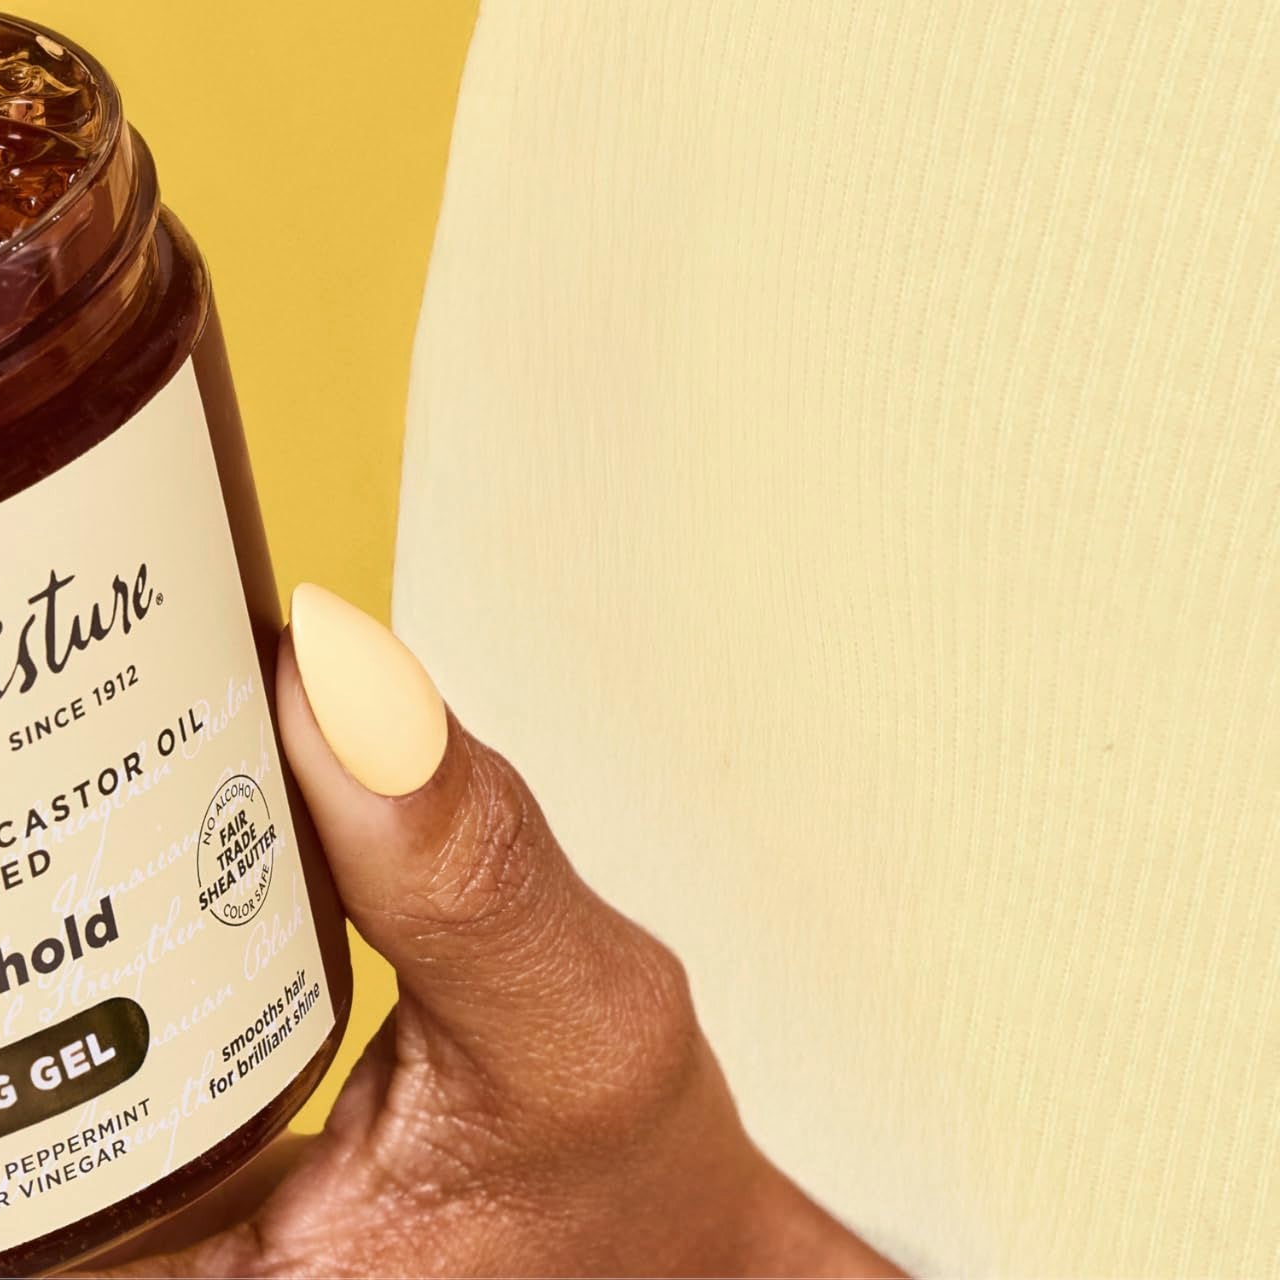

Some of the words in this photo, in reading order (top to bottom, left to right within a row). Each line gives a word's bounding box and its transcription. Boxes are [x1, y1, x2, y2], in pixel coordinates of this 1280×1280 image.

[9, 697, 86, 752] SINCE
[92, 664, 139, 706] 1912
[157, 708, 204, 757] OIL
[202, 816, 216, 846] NO
[214, 782, 256, 816] ALCOHOL
[219, 809, 249, 848] FAIR
[198, 869, 237, 911] SHEA
[236, 823, 277, 878] BUTTER
[216, 822, 257, 872] TRADE
[223, 898, 256, 919] COLOR
[254, 863, 269, 902] SAFE
[209, 1070, 234, 1099] for
[236, 1017, 293, 1079] brilliant
[293, 982, 320, 1026] shine
[221, 997, 284, 1063] smooths
[283, 969, 306, 1006] hair
[30, 1033, 117, 1091] GEL
[4, 1098, 150, 1180] PEPPERMINT
[18, 1139, 127, 1198] VINEGAR
